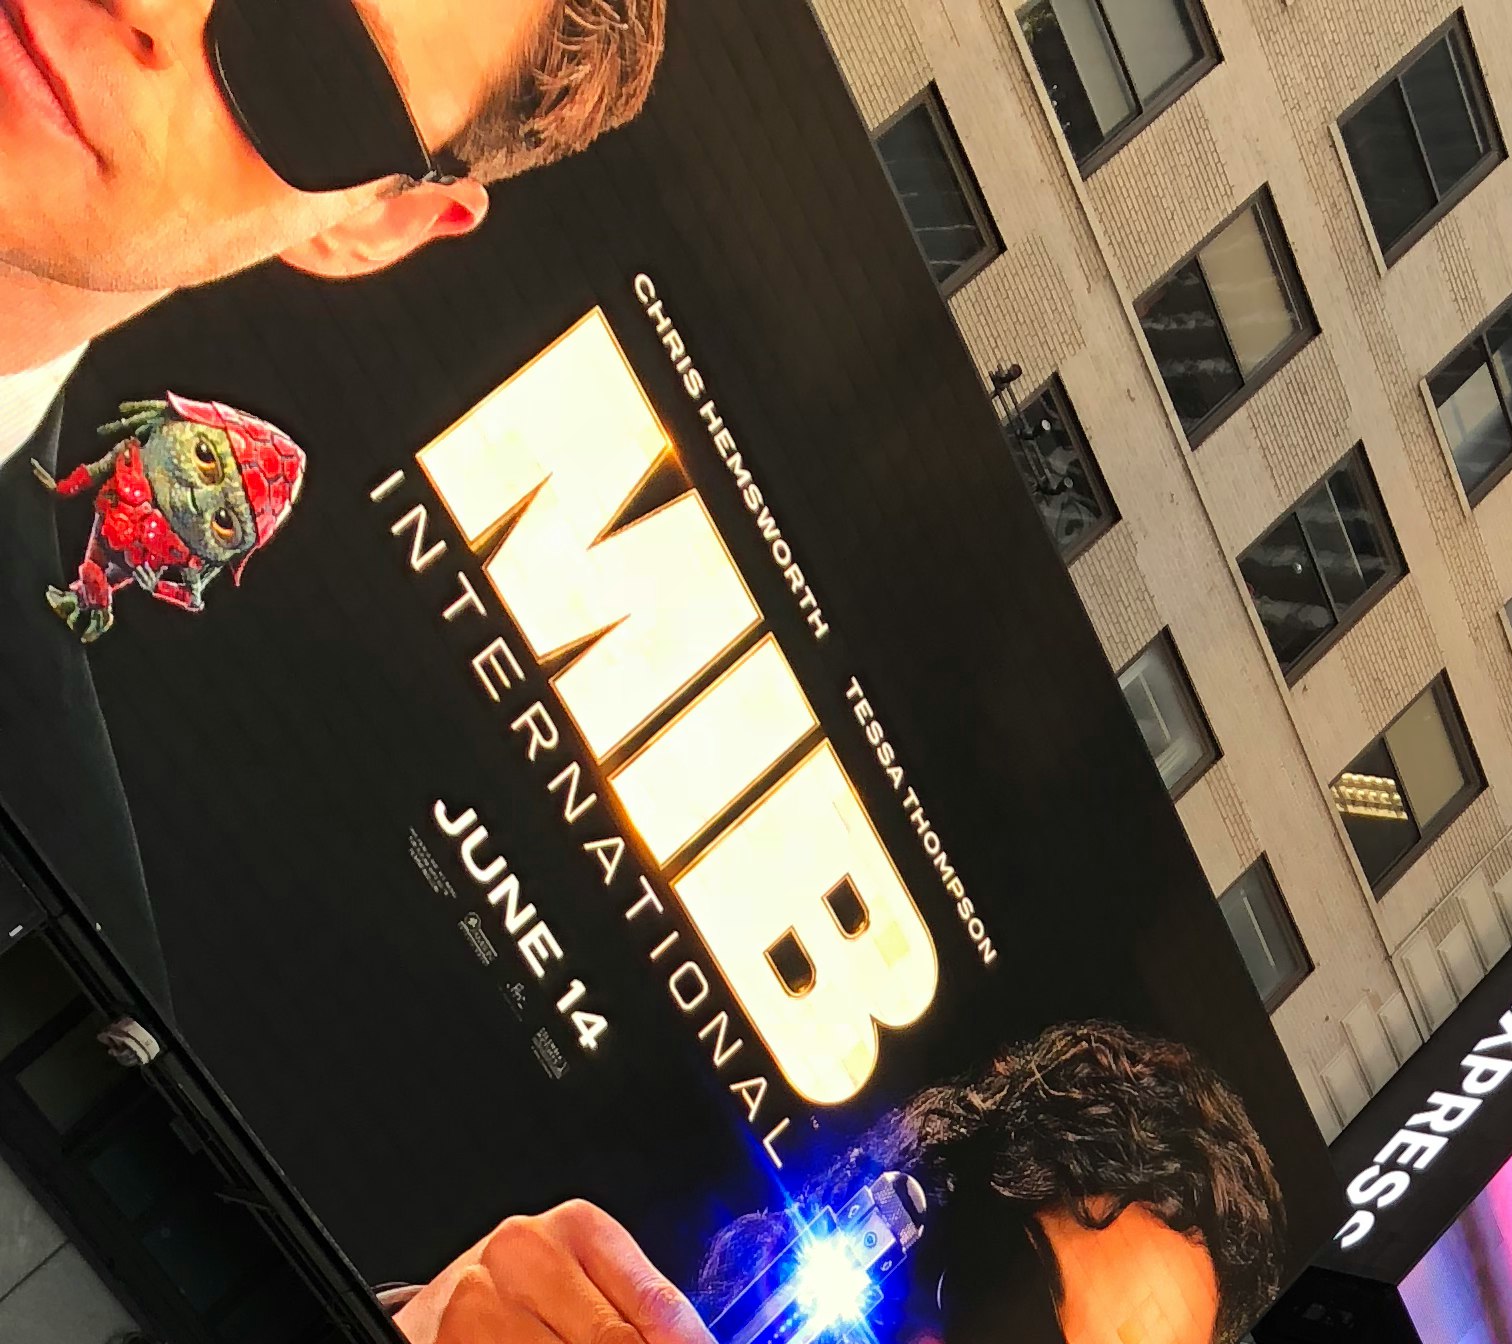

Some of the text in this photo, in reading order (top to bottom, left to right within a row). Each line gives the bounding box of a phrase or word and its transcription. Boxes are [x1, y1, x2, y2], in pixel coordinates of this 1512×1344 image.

[370, 469, 792, 1169] INTERNATIONAL
[415, 303, 940, 1107] MIB
[434, 798, 564, 978] JUNE
[555, 979, 608, 1051] 14
[633, 272, 999, 966] CHRIS HEMSWORTH TESSA THOMPSON
